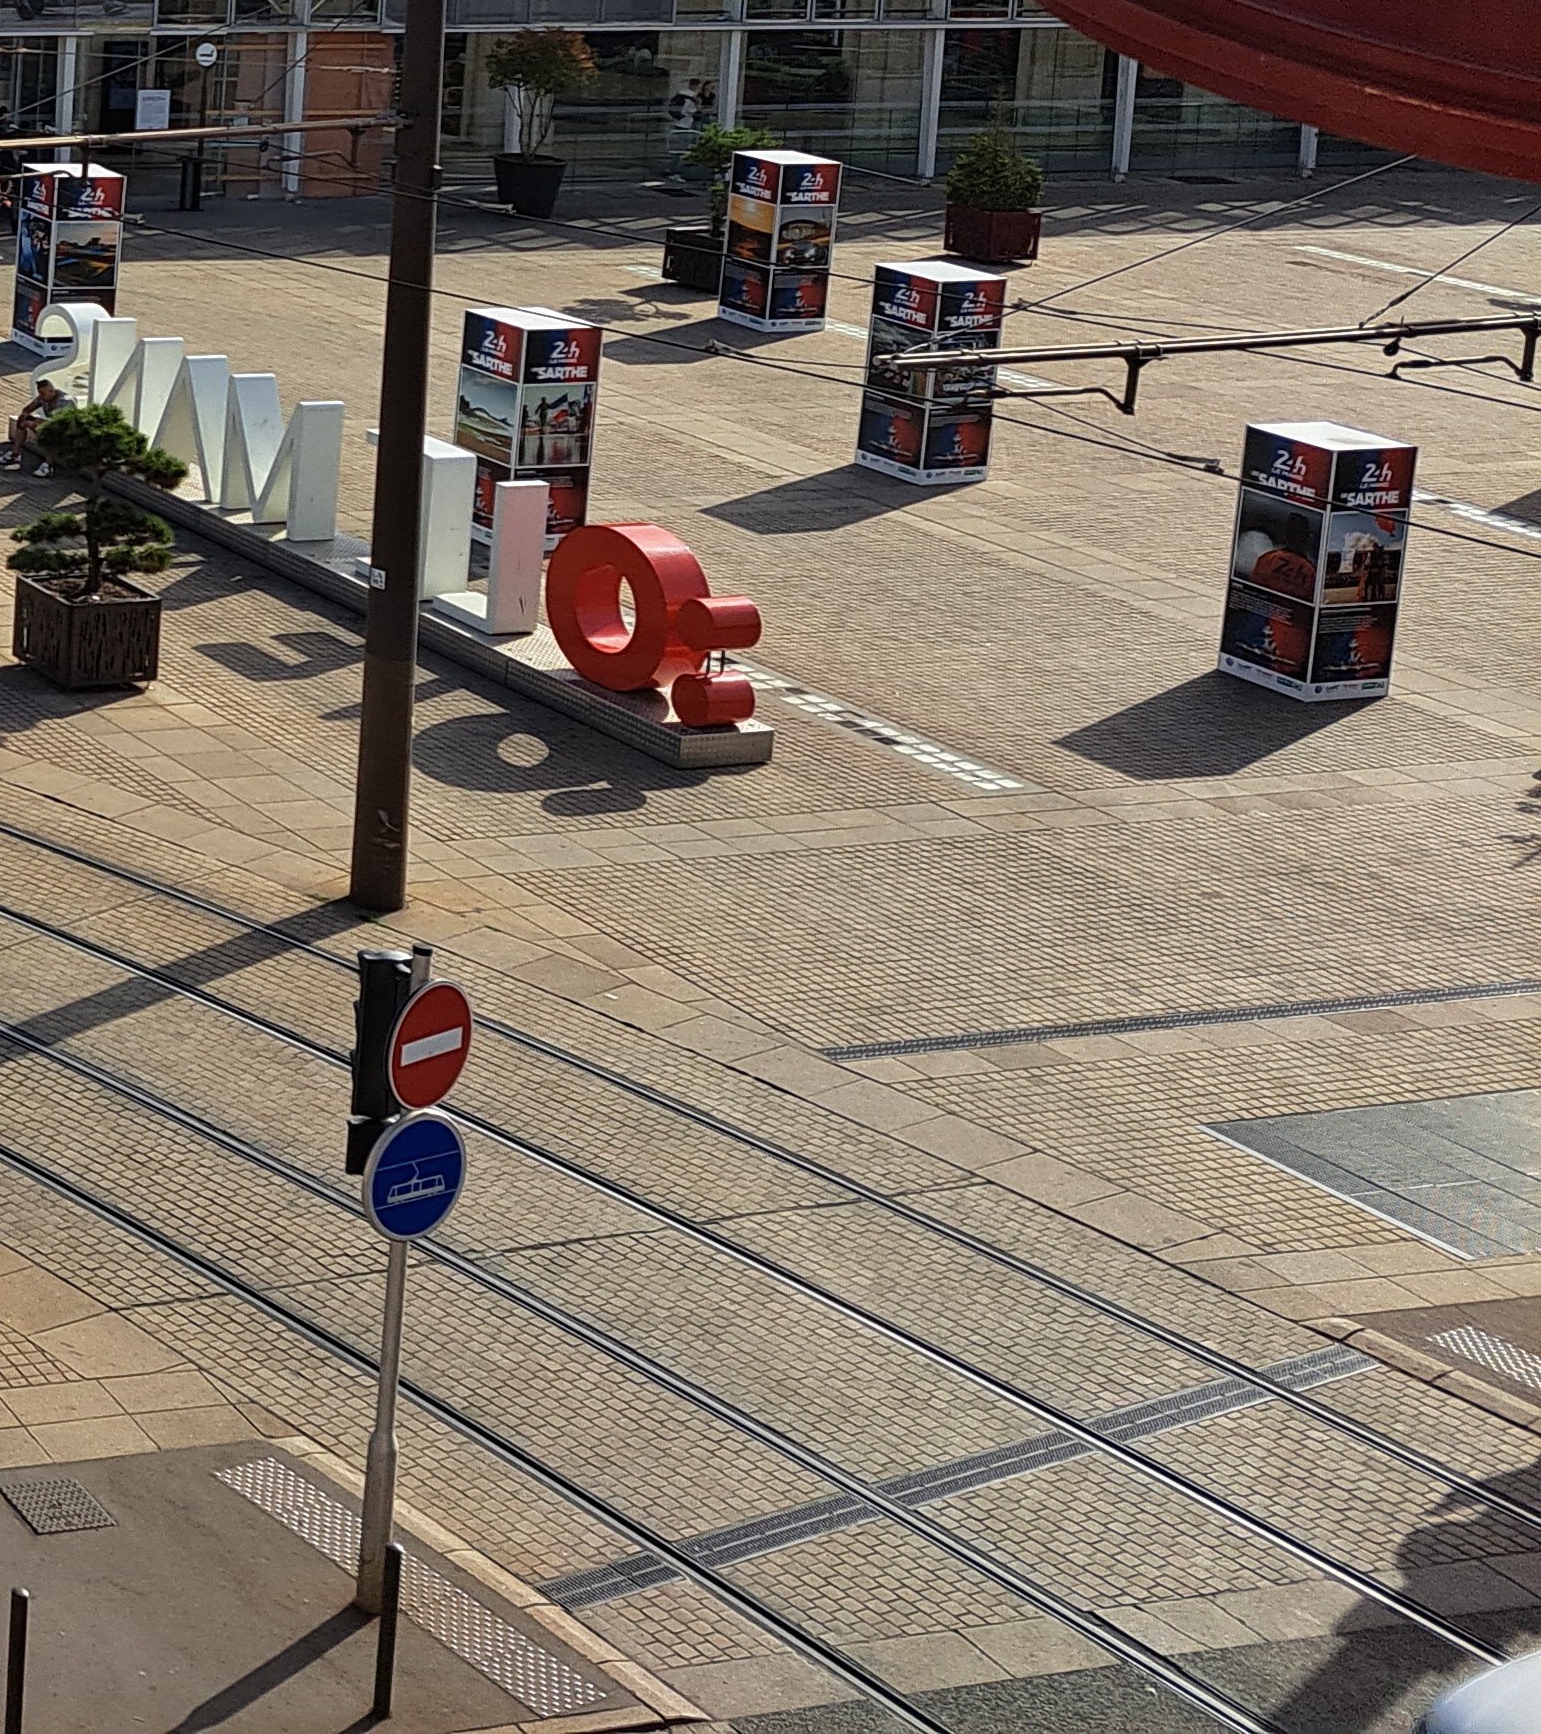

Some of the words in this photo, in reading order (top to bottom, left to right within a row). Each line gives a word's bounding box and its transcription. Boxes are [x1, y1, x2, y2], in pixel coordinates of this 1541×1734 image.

[472, 351, 513, 376] SARTHE
[537, 366, 588, 380] SARTHE
[1347, 490, 1400, 507] SARTHE
